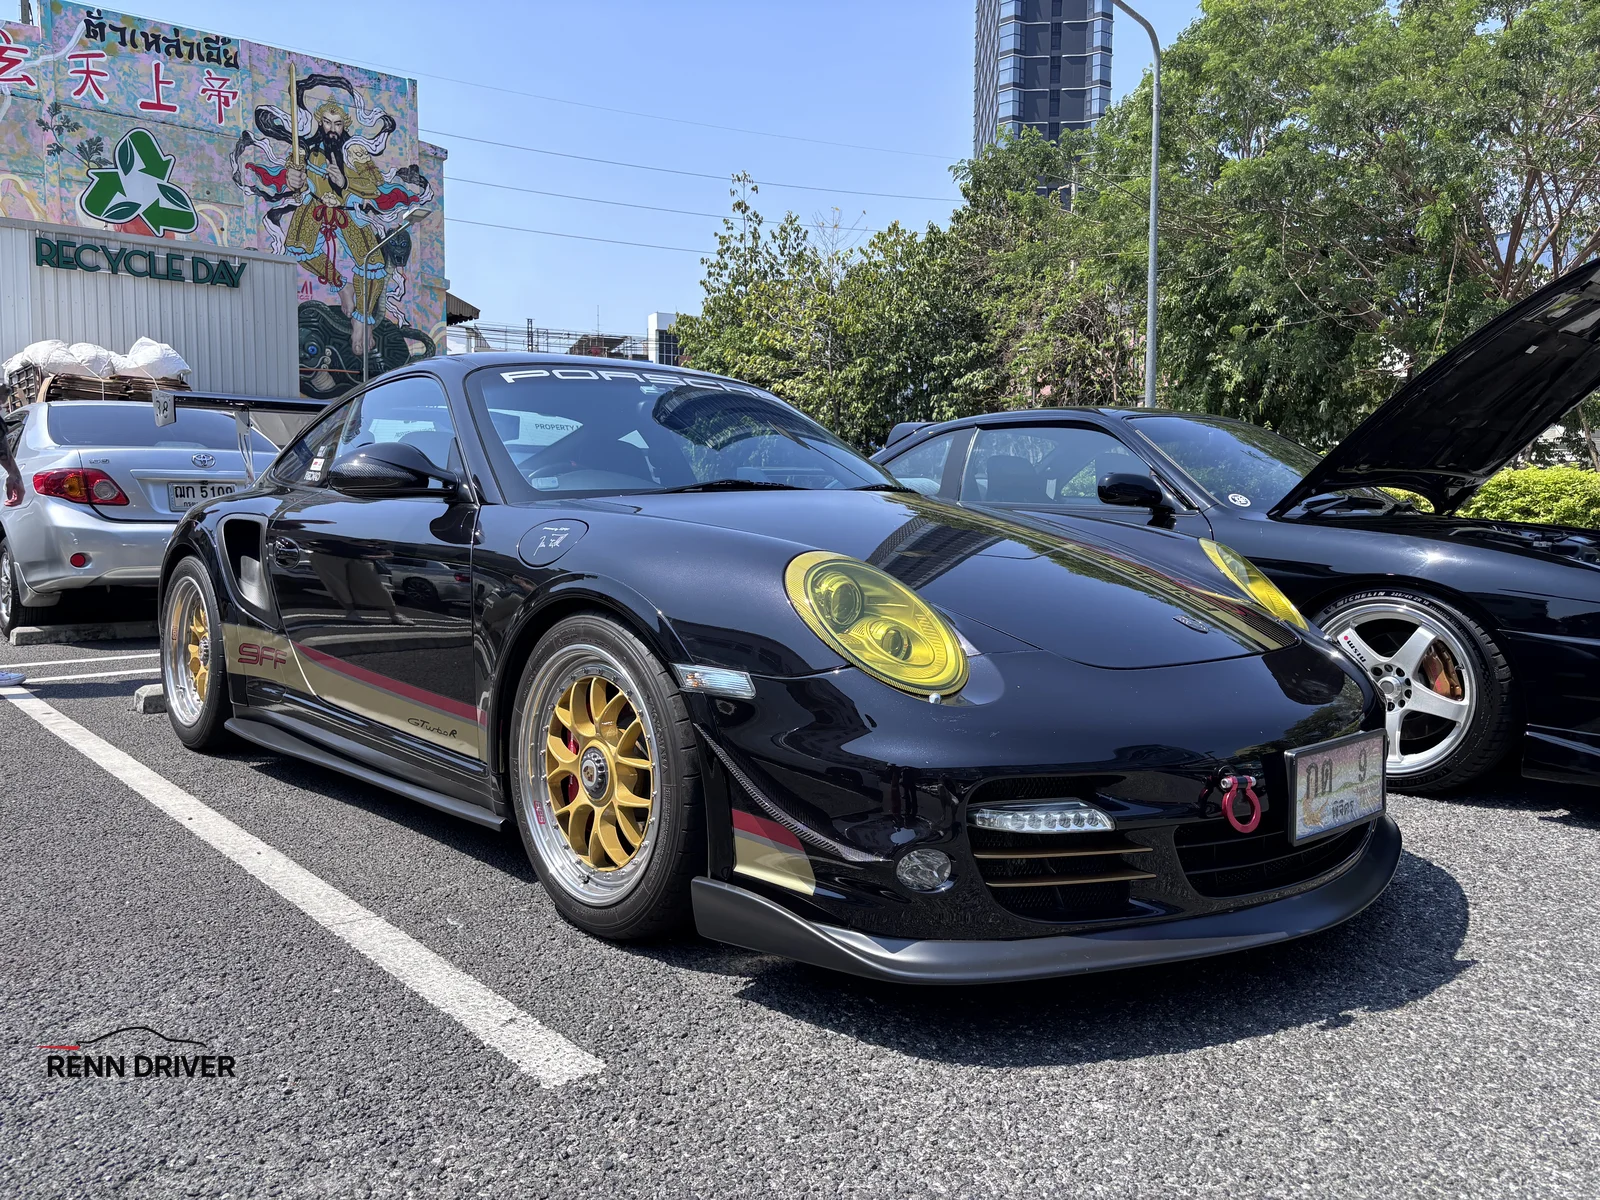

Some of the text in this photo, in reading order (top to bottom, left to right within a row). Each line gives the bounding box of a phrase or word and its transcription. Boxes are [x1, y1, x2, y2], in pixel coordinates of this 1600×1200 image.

[35, 237, 247, 288] RECYCLE DAY
[500, 369, 758, 398] PORSCH
[534, 423, 576, 431] PROPERTY
[1336, 591, 1386, 607] MICHELIN
[1358, 748, 1367, 783] 9
